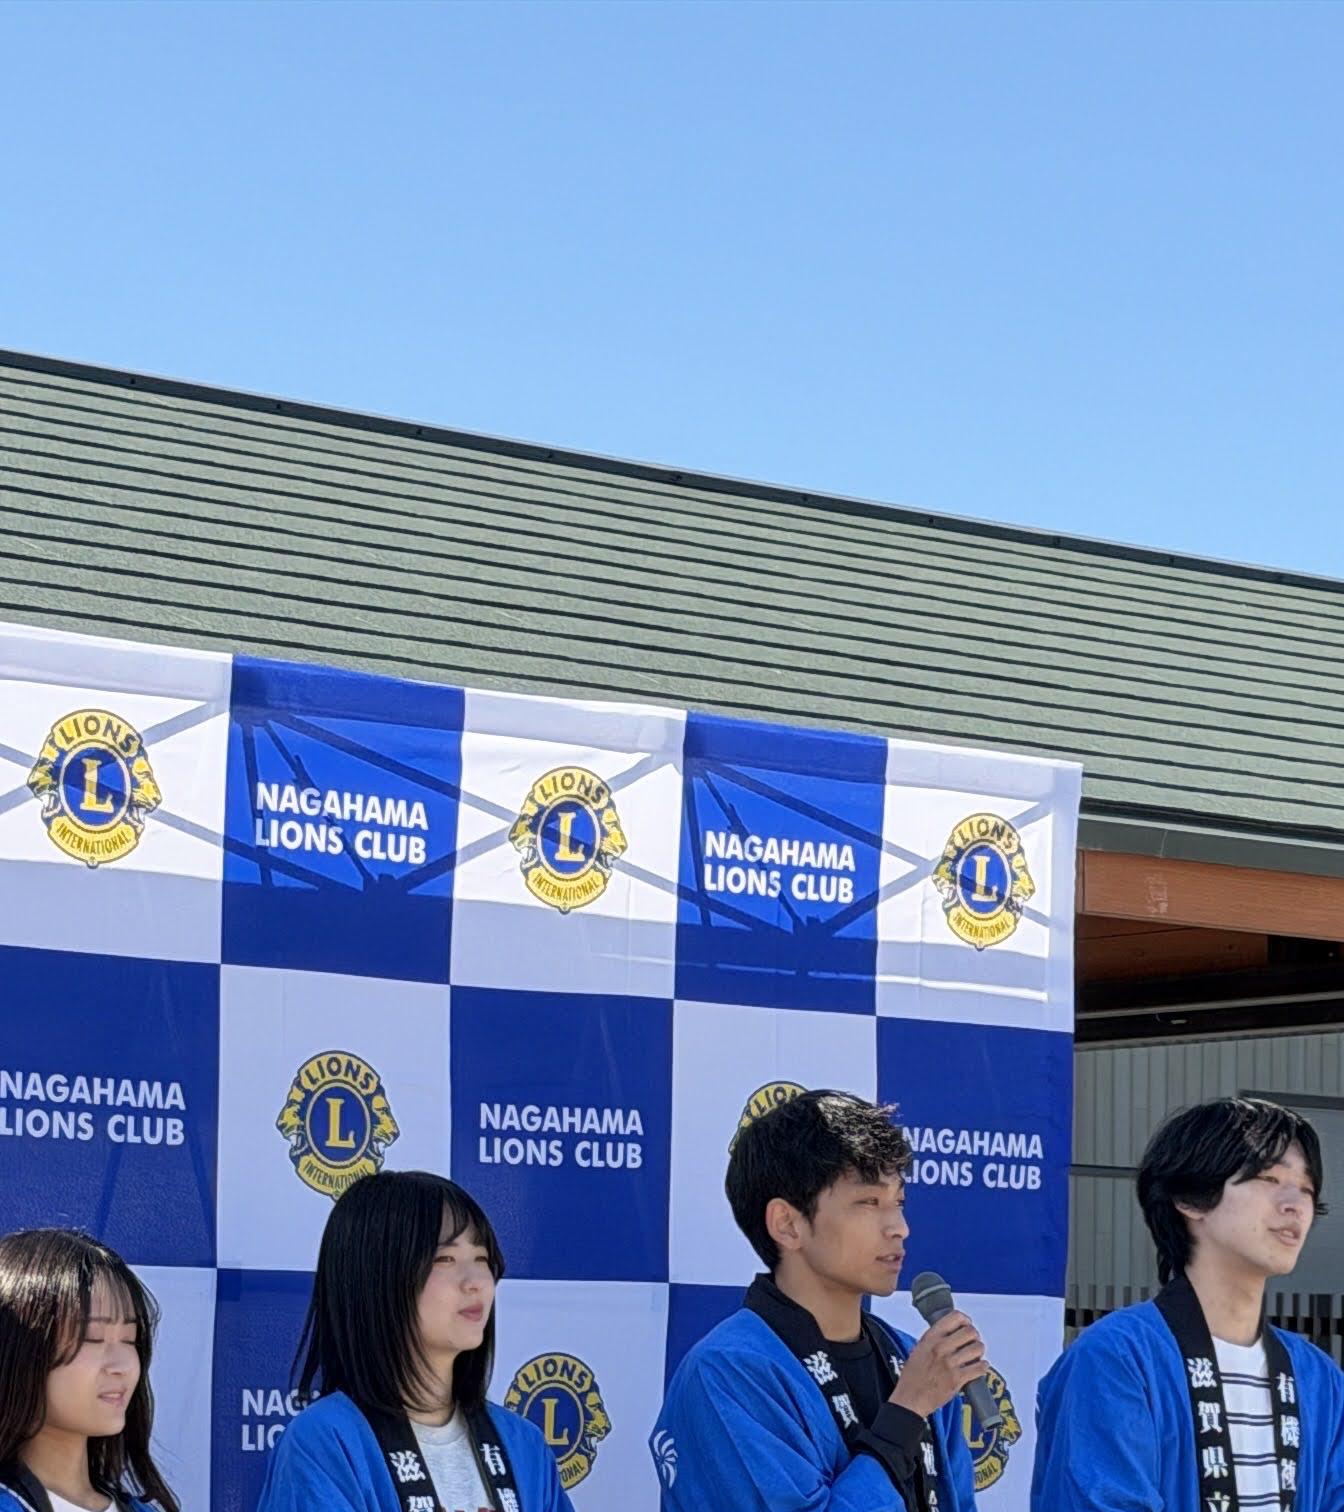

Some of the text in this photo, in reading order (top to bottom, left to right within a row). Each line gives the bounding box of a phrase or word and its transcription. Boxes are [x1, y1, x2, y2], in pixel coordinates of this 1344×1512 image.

[59, 715, 137, 750] LIONS
[80, 758, 114, 813] L
[540, 773, 605, 803] LIONS
[257, 782, 428, 830] NAGAHAMA
[56, 823, 131, 855] INTERNATIONAL
[256, 819, 426, 864] LIONS CLUB
[555, 812, 585, 861] L
[704, 831, 856, 871] NAGAHAMA
[958, 819, 1013, 849] LIONS
[533, 873, 599, 901] INTERNATIONAL
[703, 864, 854, 903] LIONS CLUB
[971, 855, 997, 902] L
[304, 1056, 374, 1090] LIONS
[0, 1070, 186, 1111] NAGAHAMA
[107, 1115, 185, 1146] CLUB
[325, 1098, 355, 1148] L
[480, 1102, 644, 1136] NAGAHAMA
[479, 1136, 642, 1169] LIONS CLUB
[902, 1126, 1043, 1159] NAGAHAMA
[982, 1163, 1041, 1190] CLUB
[521, 1358, 589, 1389] LIONS
[541, 1398, 569, 1445] L
